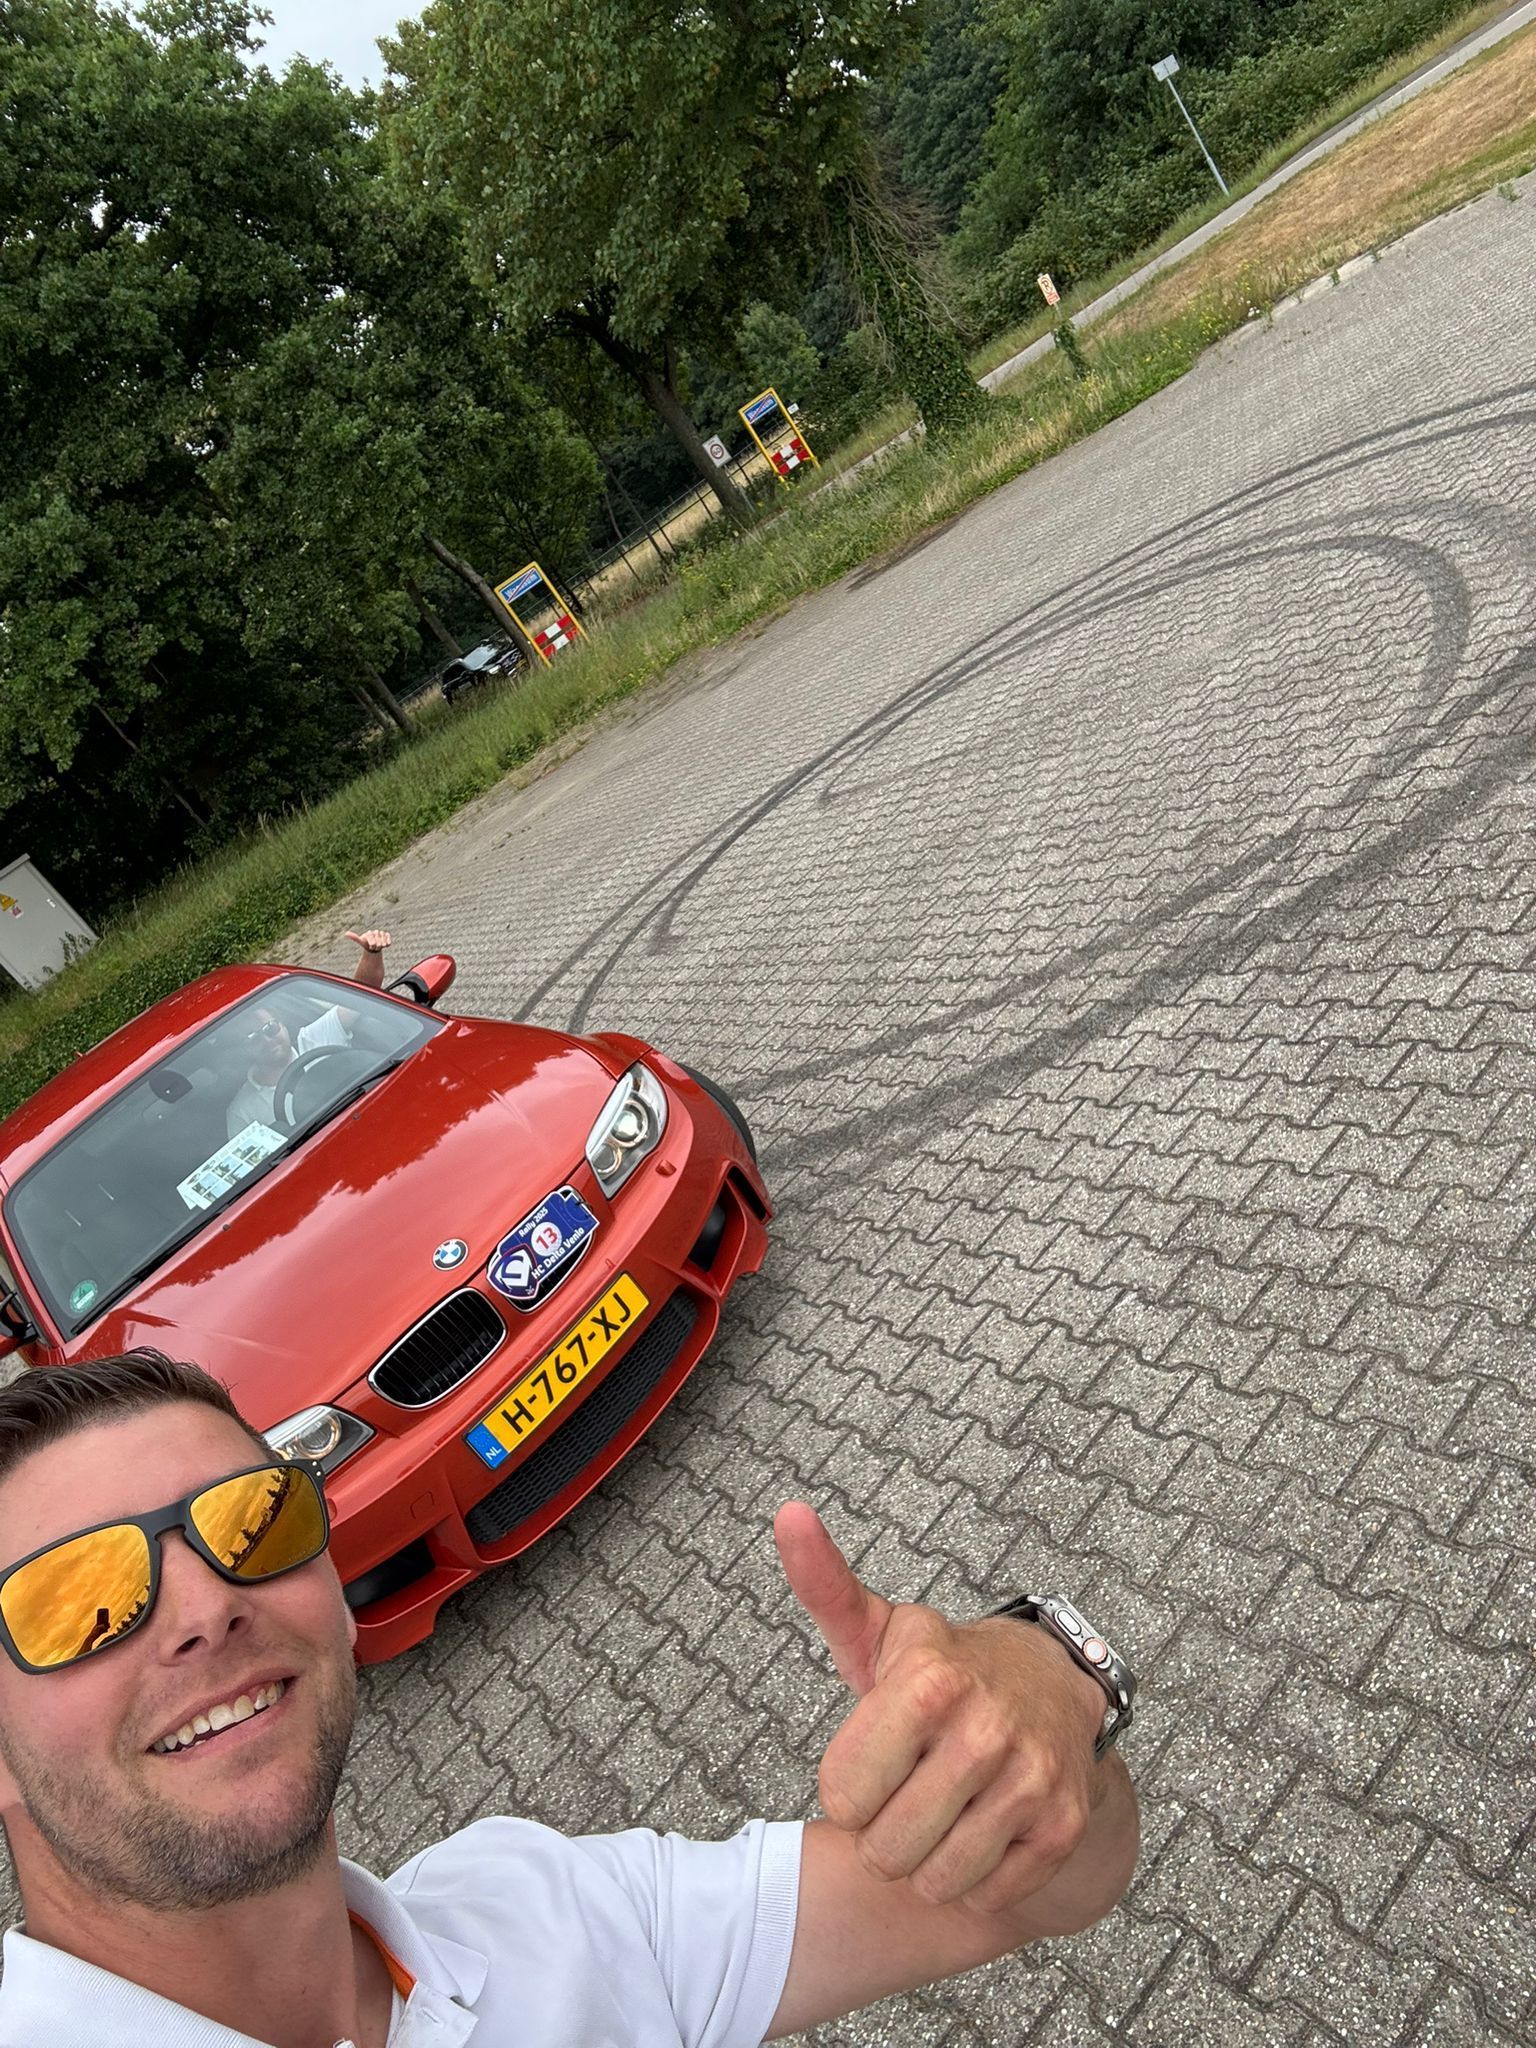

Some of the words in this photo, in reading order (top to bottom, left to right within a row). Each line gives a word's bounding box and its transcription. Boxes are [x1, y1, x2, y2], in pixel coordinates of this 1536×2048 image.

[518, 1218, 537, 1238] Rally
[533, 1206, 549, 1222] 2025
[531, 1264, 546, 1279] HC
[543, 1246, 565, 1269] Delta
[563, 1226, 585, 1249] Venlo
[535, 1227, 559, 1250] 13
[501, 1292, 632, 1435] H-767-XJ
[485, 1445, 502, 1461] NL
